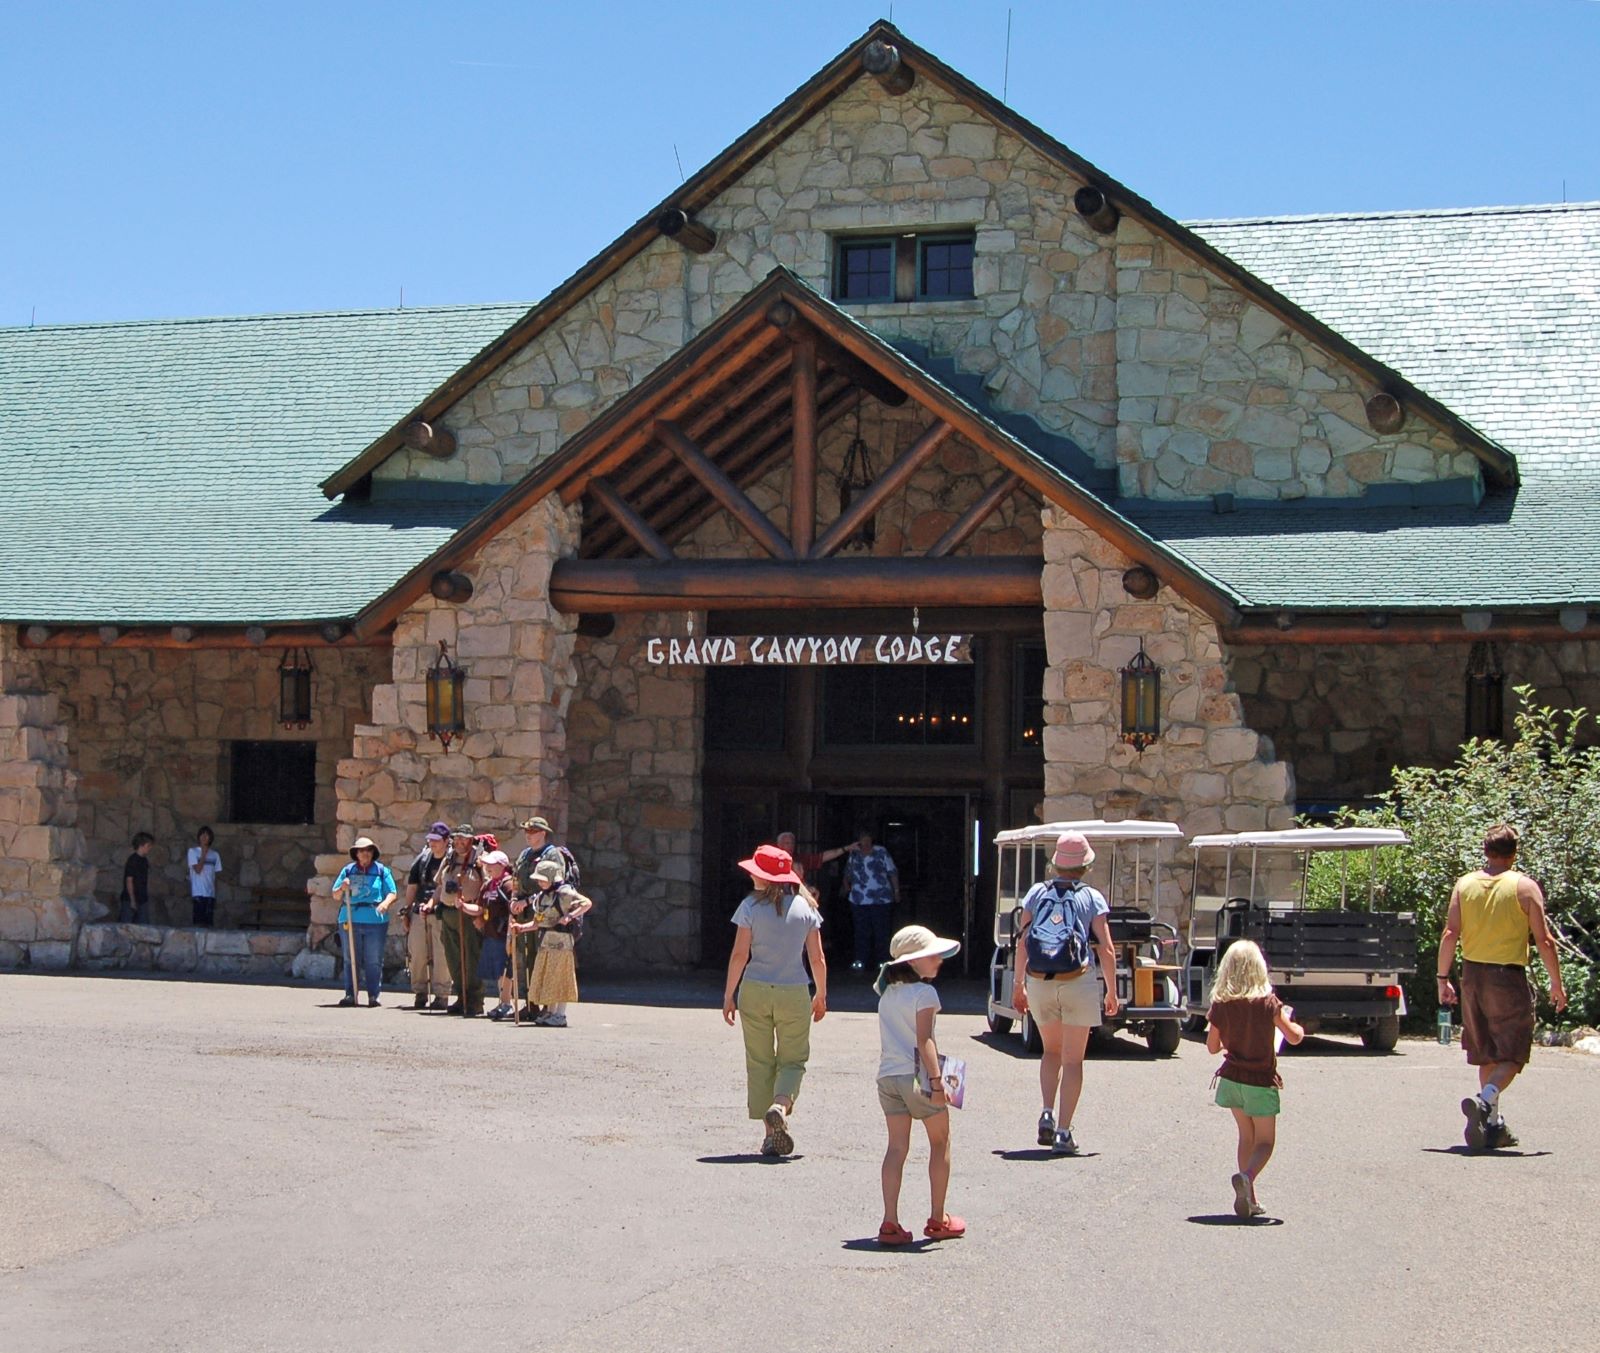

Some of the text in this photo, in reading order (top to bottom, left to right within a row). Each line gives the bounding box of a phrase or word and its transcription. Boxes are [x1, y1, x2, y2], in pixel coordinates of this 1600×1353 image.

[647, 635, 961, 664] GRAND CANYON LODGE
